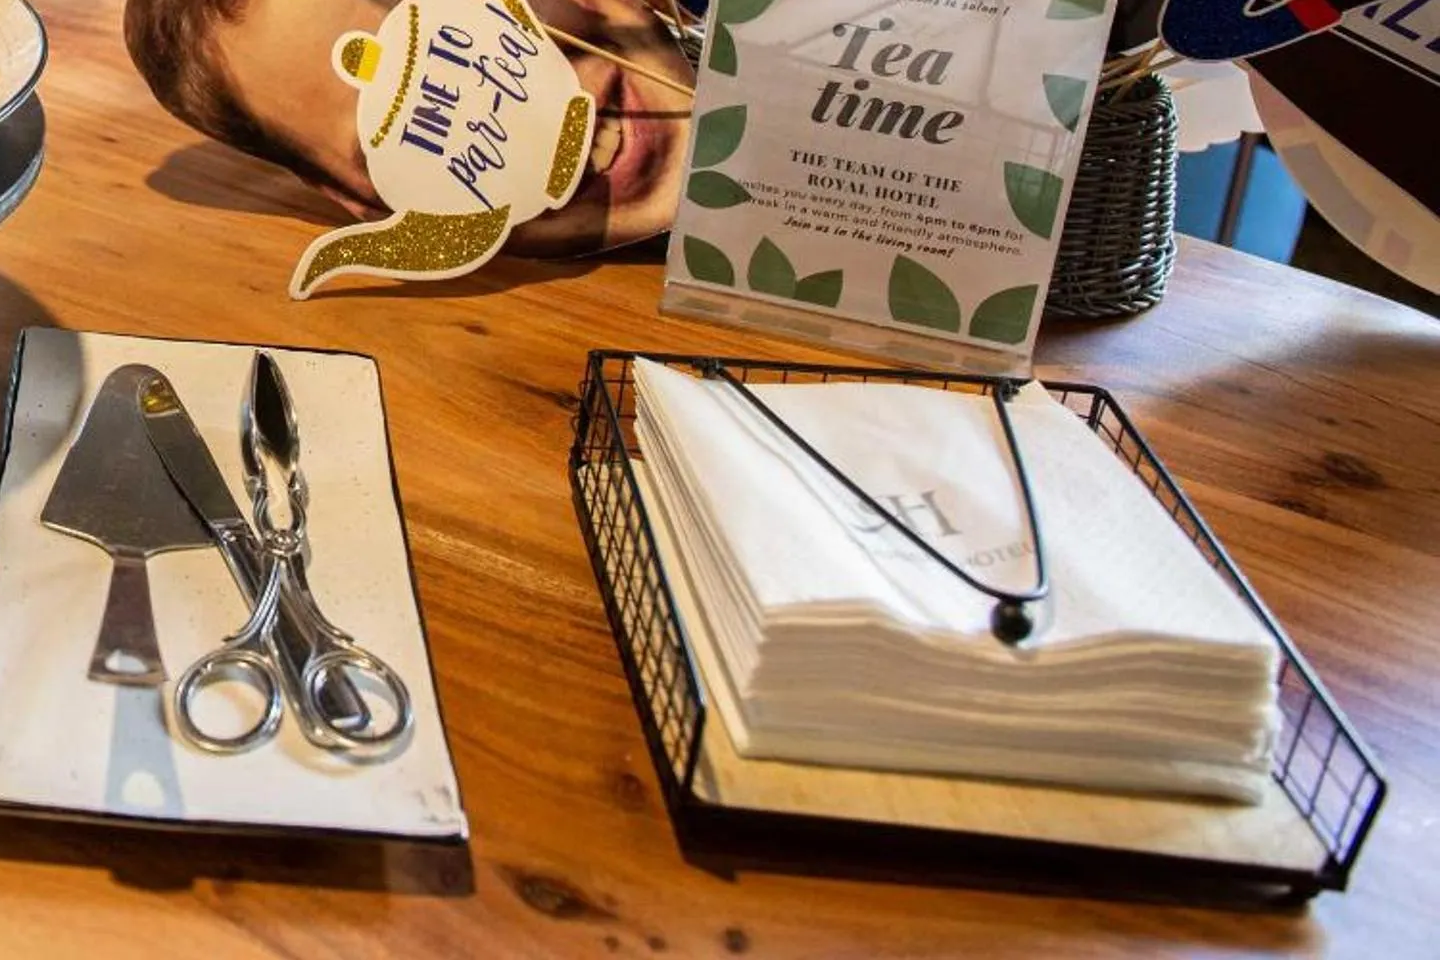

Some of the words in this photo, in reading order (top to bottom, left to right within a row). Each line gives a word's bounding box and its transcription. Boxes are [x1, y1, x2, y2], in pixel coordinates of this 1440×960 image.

[960, 1, 998, 16] salon
[427, 24, 474, 68] TO
[828, 17, 954, 86] Tea
[399, 73, 460, 157] TIME
[811, 77, 965, 145] time
[789, 148, 828, 169] THE
[833, 156, 886, 179] TEAM
[891, 168, 918, 184] OF
[922, 173, 963, 194] THE
[807, 172, 869, 198] ROYAL
[875, 185, 940, 209] HOTEL
[744, 197, 779, 209] reak
[784, 200, 797, 213] in
[799, 206, 808, 215] a
[811, 207, 849, 222] warm
[852, 216, 879, 229] and
[881, 219, 935, 240] friendly
[782, 190, 809, 201] you
[810, 194, 845, 208] every
[880, 204, 912, 220] from
[915, 212, 948, 227] 4pm
[950, 219, 966, 231] to
[968, 222, 1001, 238] 6pm
[1005, 228, 1024, 243] for
[782, 215, 812, 230] Join
[814, 223, 830, 234] us
[833, 225, 849, 237] in
[851, 228, 873, 242] the
[875, 233, 913, 253] living
